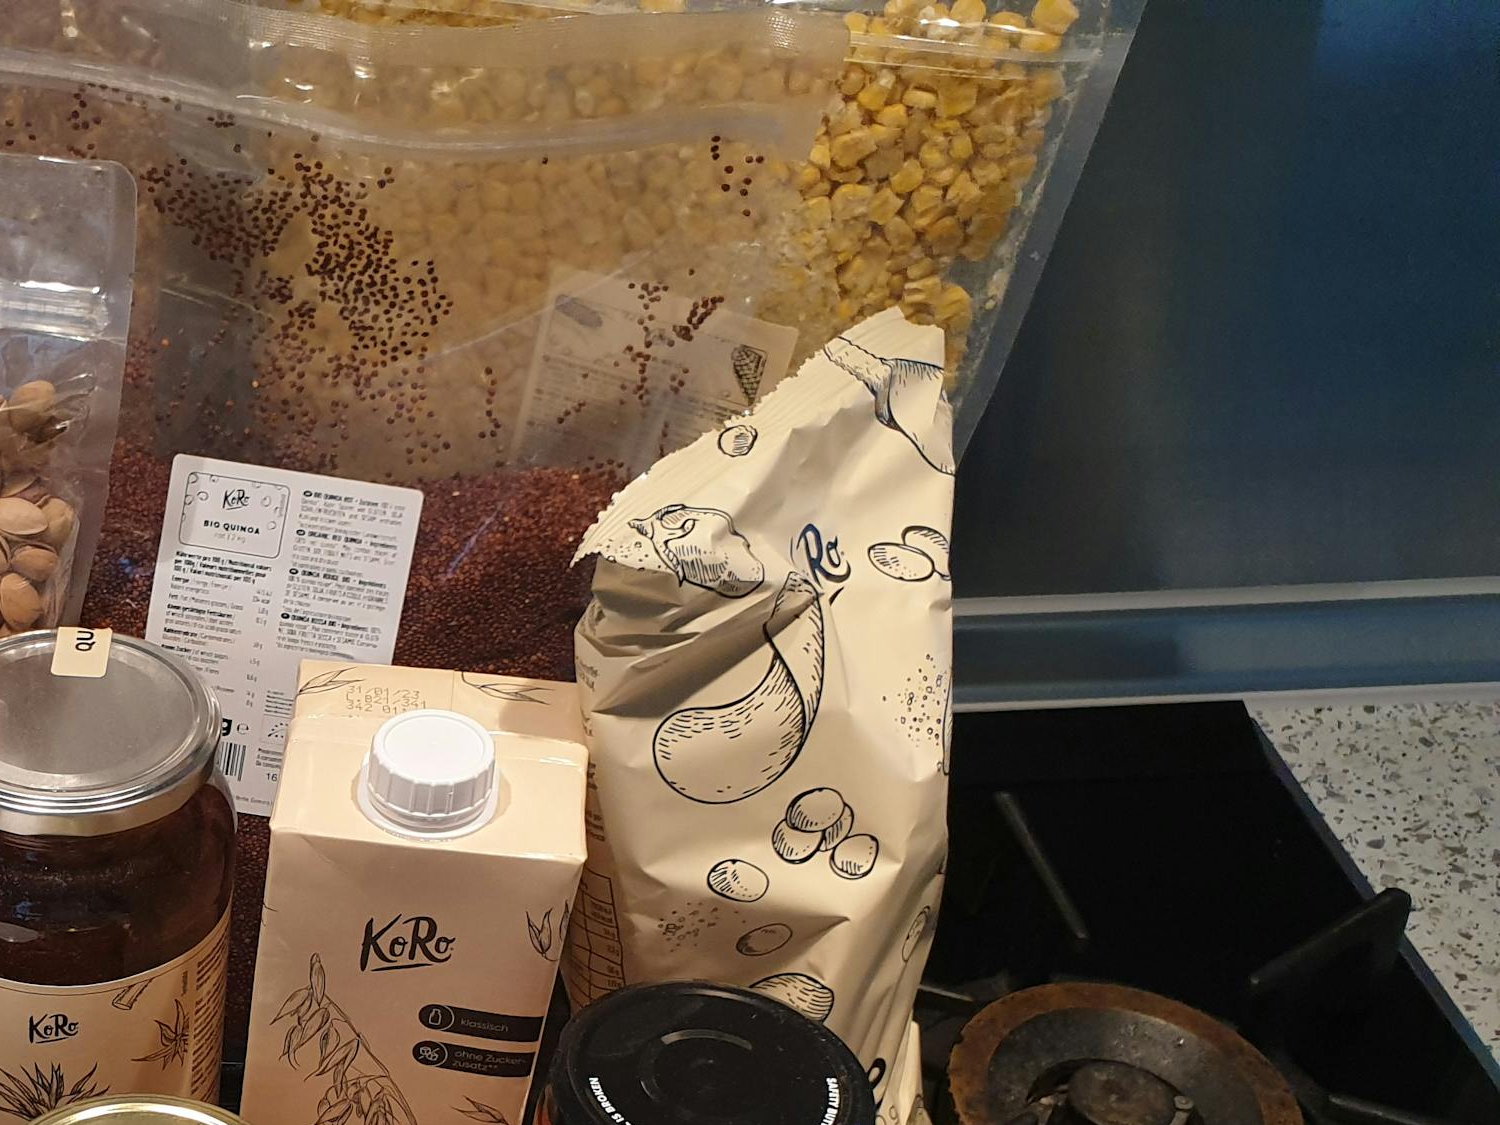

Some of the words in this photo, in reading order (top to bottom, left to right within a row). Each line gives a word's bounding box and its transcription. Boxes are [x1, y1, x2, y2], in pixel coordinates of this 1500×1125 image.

[203, 520, 220, 528] BIO
[223, 523, 260, 534] QUINOA
[359, 913, 457, 972] KoRo
[28, 1013, 79, 1044] KoRo
[460, 1016, 509, 1032] klassisch
[454, 1049, 482, 1060] ohne
[588, 1077, 616, 1113] BROKEN
[826, 1077, 840, 1108] SAFETY
[611, 1113, 624, 1123] IS
